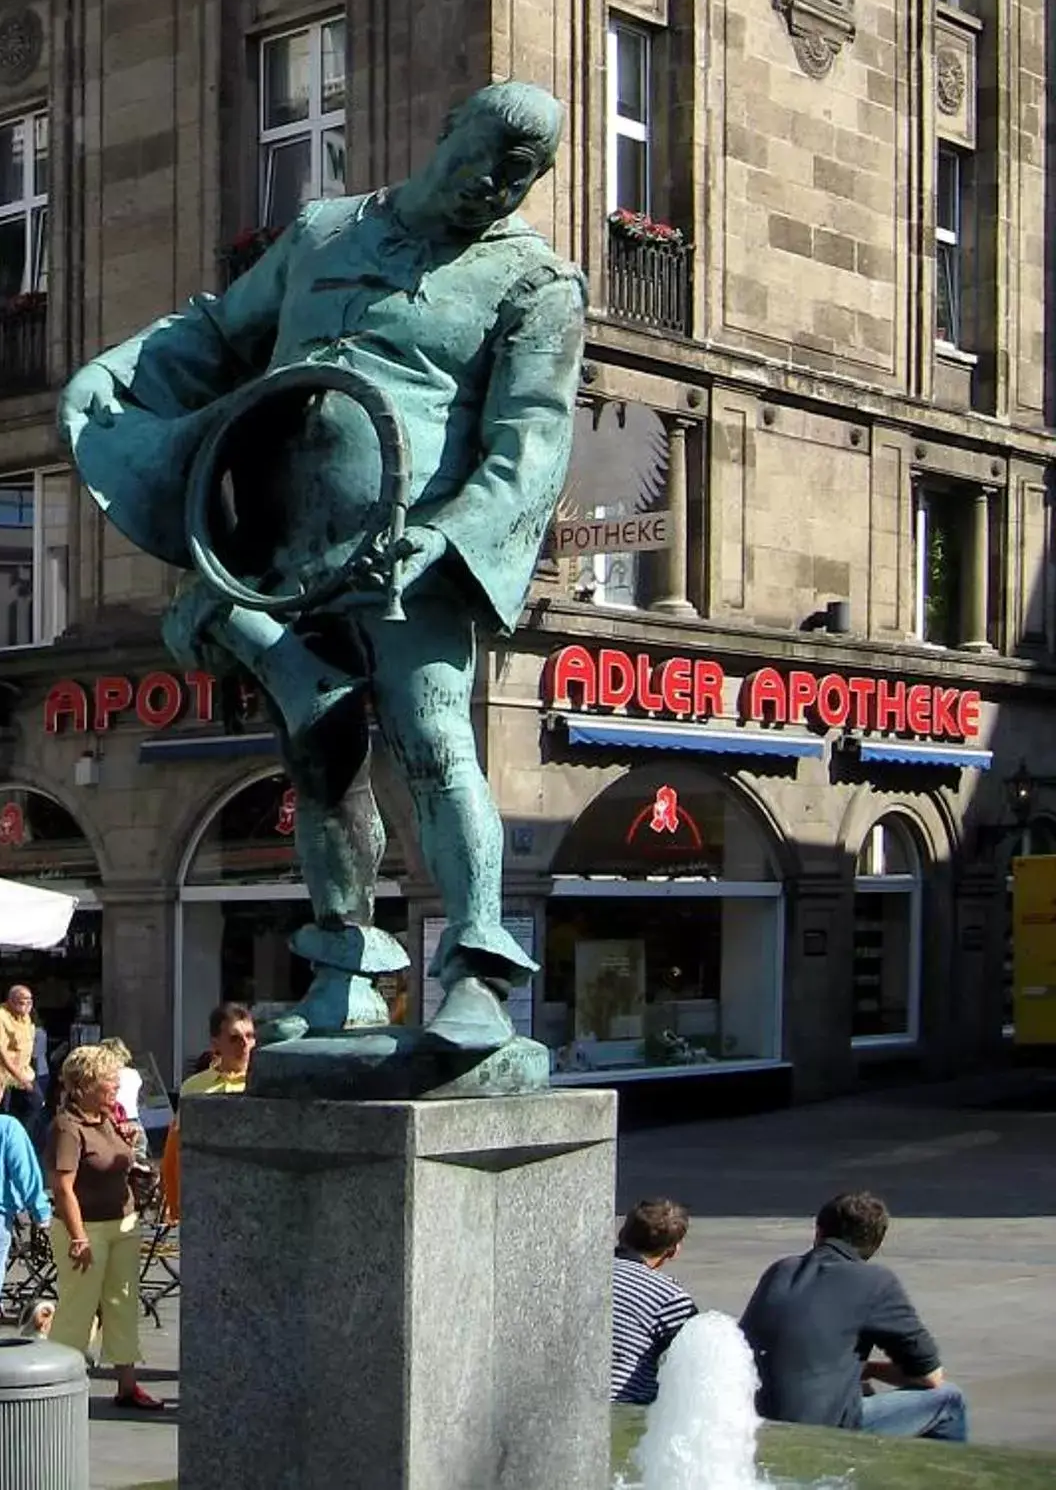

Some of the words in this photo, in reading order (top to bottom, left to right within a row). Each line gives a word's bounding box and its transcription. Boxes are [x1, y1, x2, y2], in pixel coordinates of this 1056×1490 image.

[45, 670, 217, 734] APOT
[553, 645, 725, 718] ADLER
[750, 666, 981, 737] APOTHEKE
